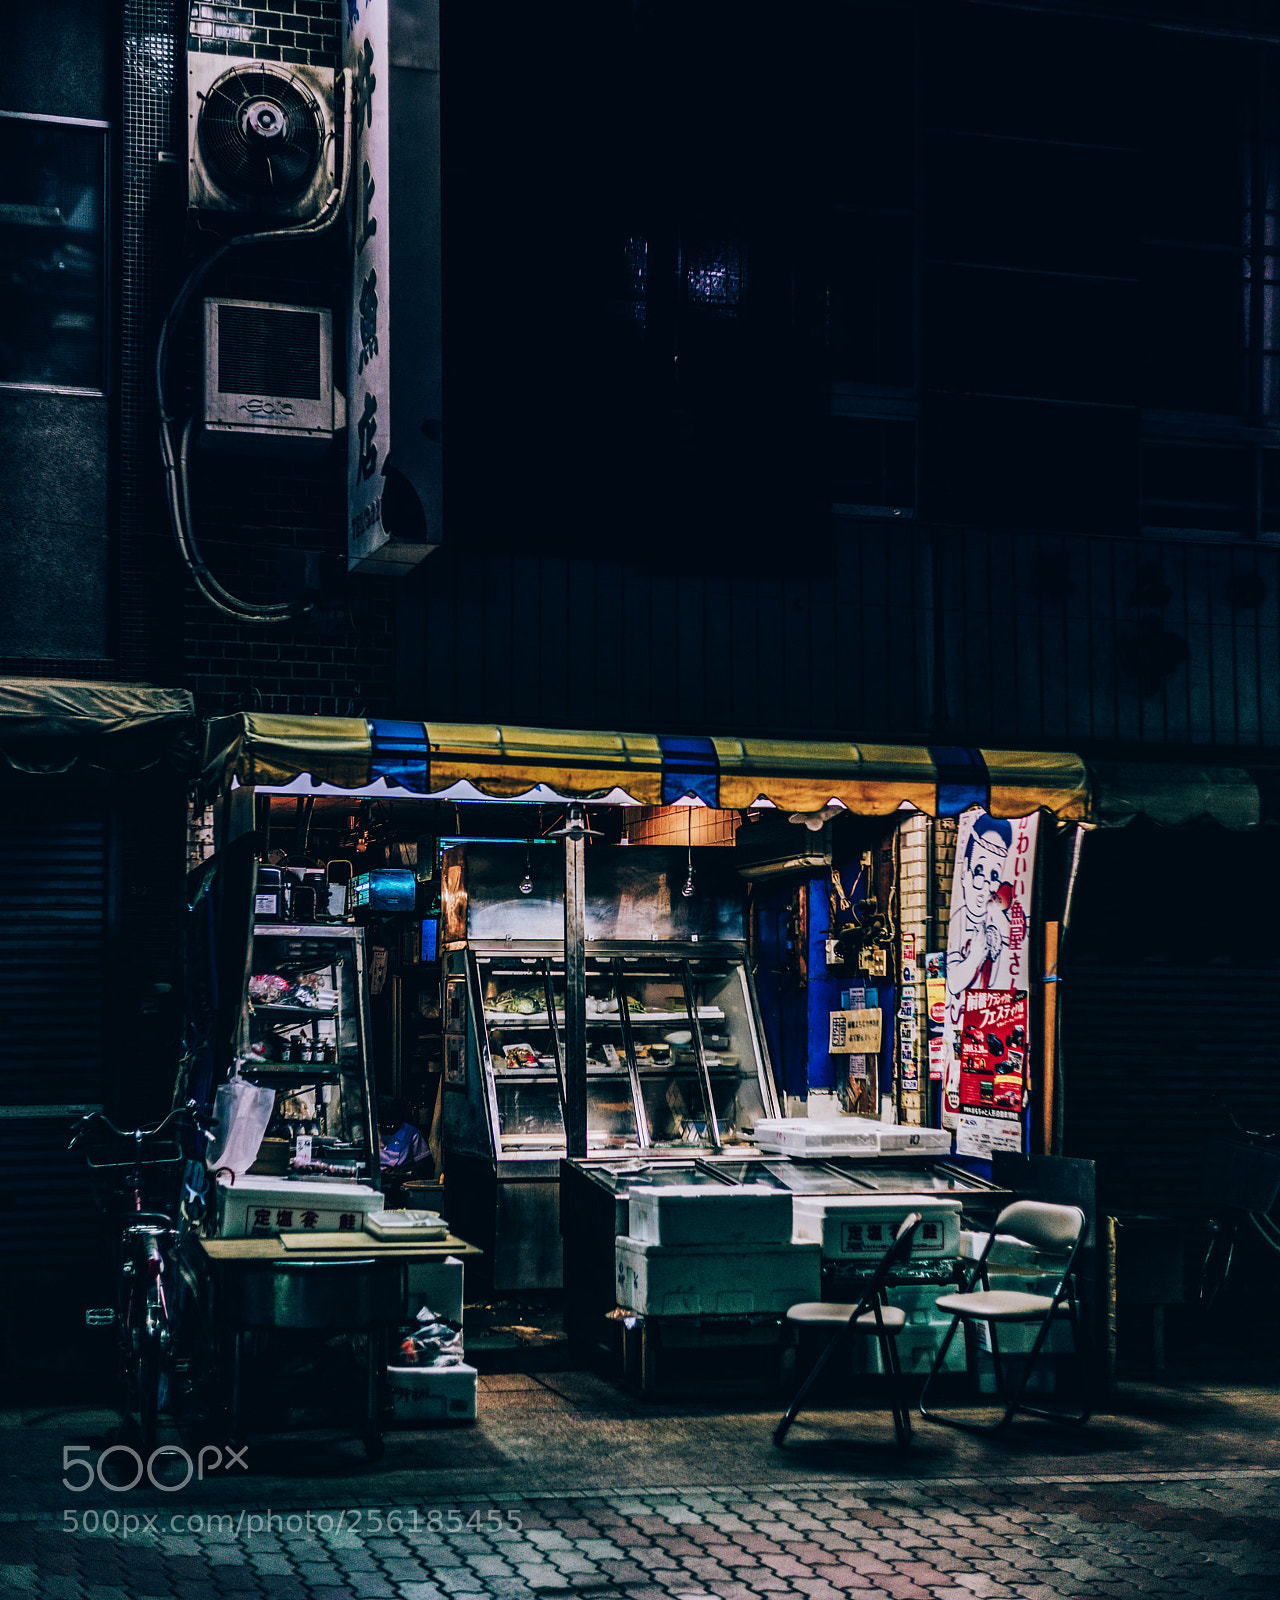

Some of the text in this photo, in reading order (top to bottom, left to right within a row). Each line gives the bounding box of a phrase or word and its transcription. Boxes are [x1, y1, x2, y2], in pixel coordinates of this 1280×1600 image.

[1009, 816, 1029, 992] わいい魚屋さ
